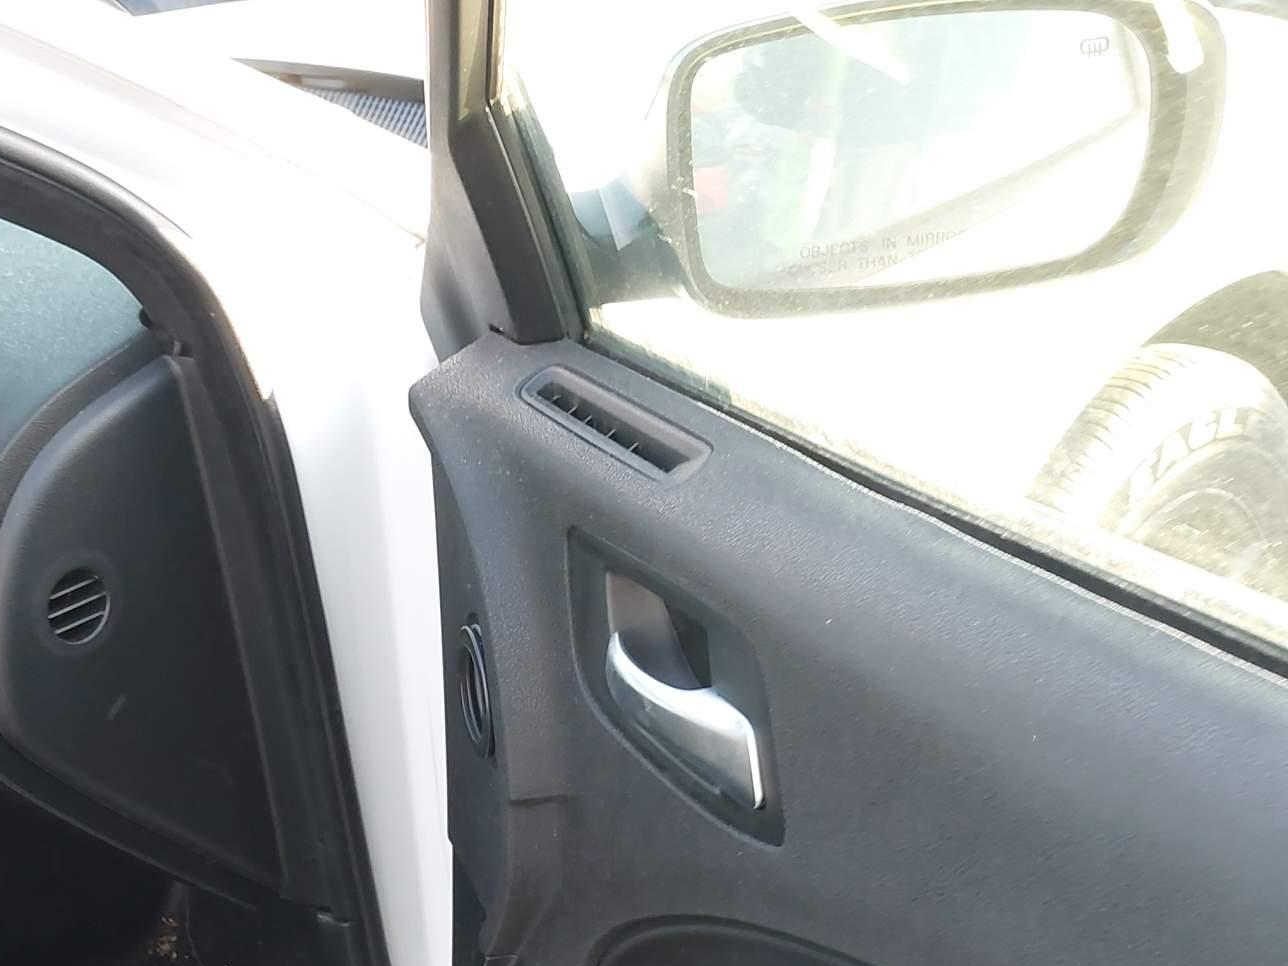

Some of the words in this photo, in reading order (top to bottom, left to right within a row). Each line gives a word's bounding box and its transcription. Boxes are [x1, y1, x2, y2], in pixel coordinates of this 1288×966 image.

[799, 239, 870, 258] OBJECTS
[882, 236, 897, 249] IN
[857, 254, 898, 272] THAN
